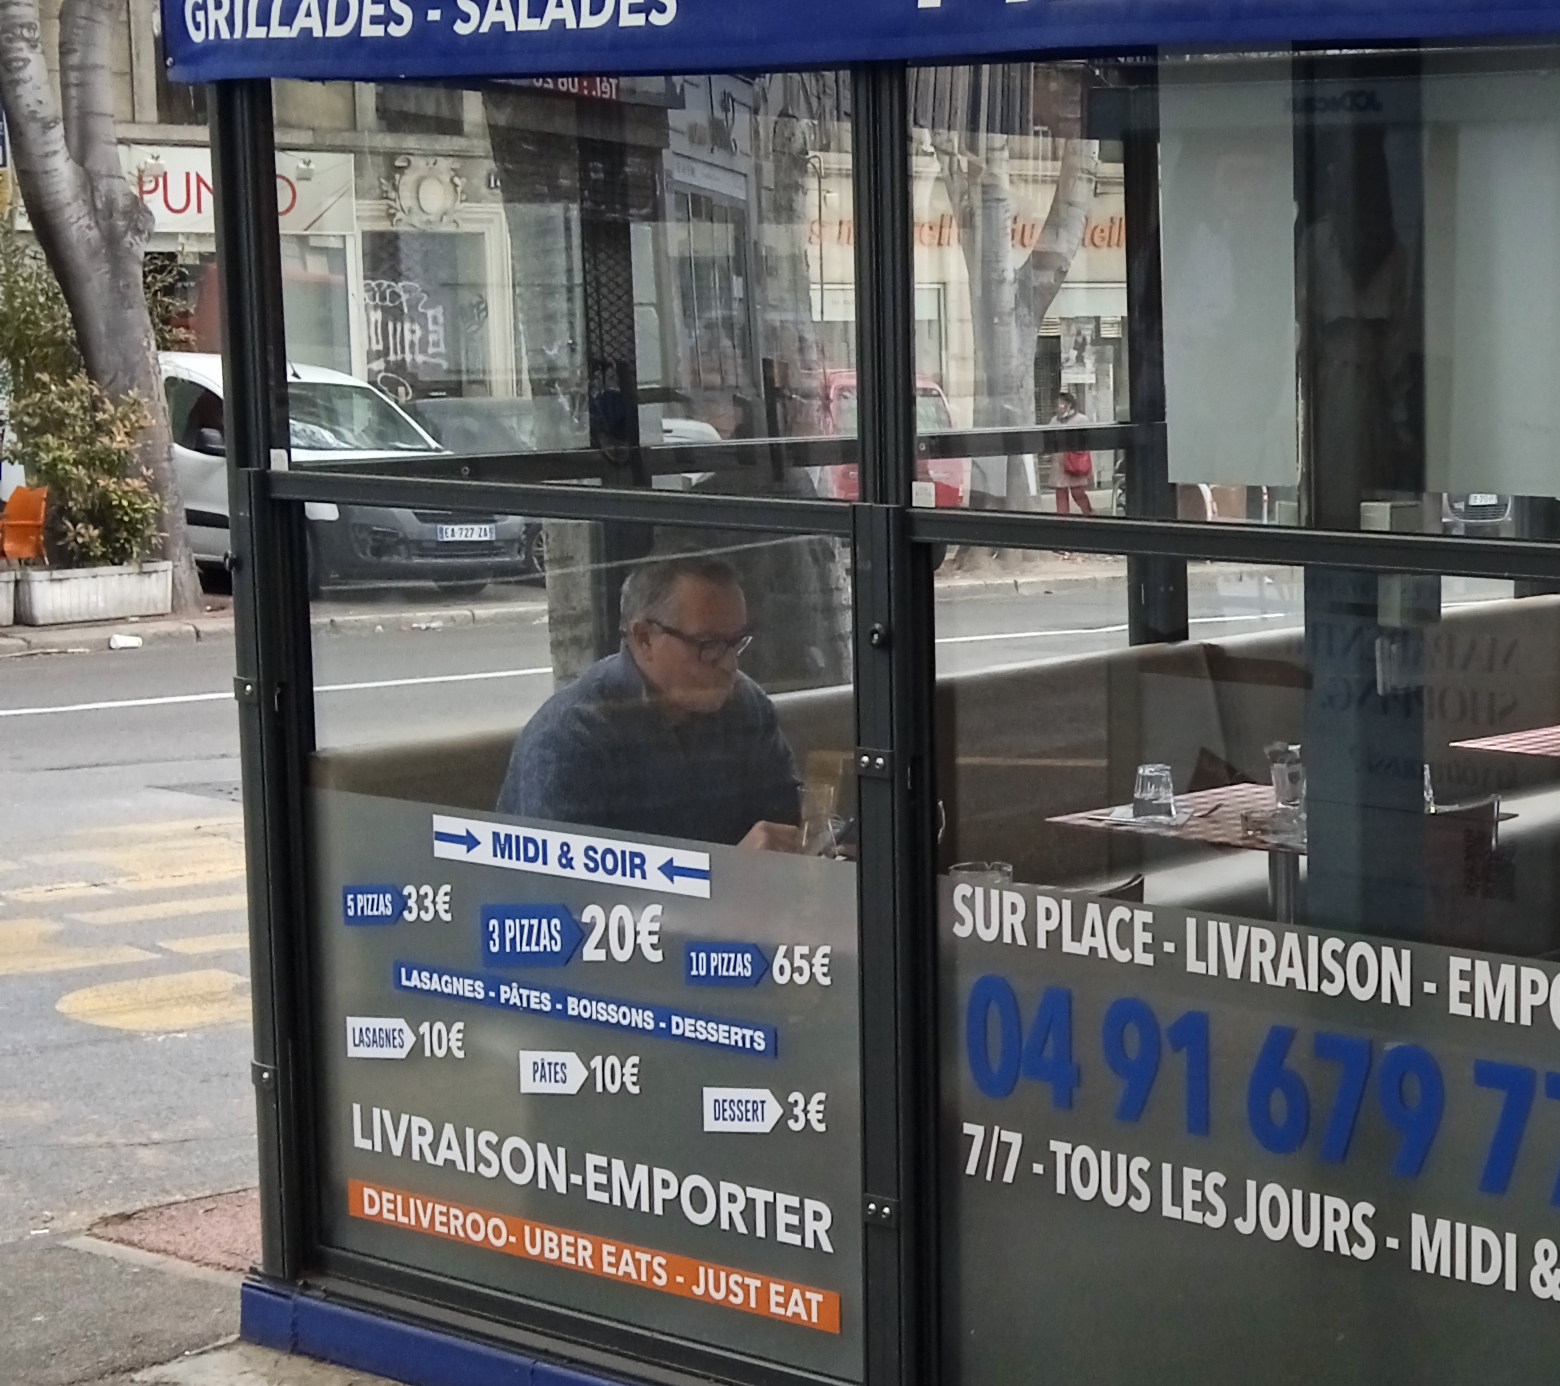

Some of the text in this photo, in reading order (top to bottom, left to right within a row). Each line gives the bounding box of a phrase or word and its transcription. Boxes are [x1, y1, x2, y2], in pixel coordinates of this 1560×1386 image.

[491, 831, 648, 882] MIDI & SOIR
[489, 916, 563, 955] 3 PIZZAS
[581, 903, 664, 964] 20€
[952, 884, 1027, 947] SUR
[1036, 897, 1154, 966] PLACE
[1185, 916, 1412, 1007] LIVRAISON
[400, 966, 765, 1052] LASAGNES PÂTES BOISSONS DESSERTS
[966, 974, 1080, 1110] 04
[1102, 996, 1211, 1137] 91
[1247, 1024, 1445, 1180] 679
[352, 1103, 834, 1254] LIVRAISON-EMPORTER
[962, 1123, 1022, 1185] 7/7
[1050, 1138, 1151, 1214] TOUS
[1162, 1162, 1227, 1228] LES
[1234, 1178, 1376, 1261] JOURS
[1410, 1212, 1517, 1292] MIDI
[524, 1228, 595, 1272] UBER
[601, 1247, 668, 1288] EATS
[691, 1265, 761, 1307] JUST
[769, 1284, 823, 1325] EAT
